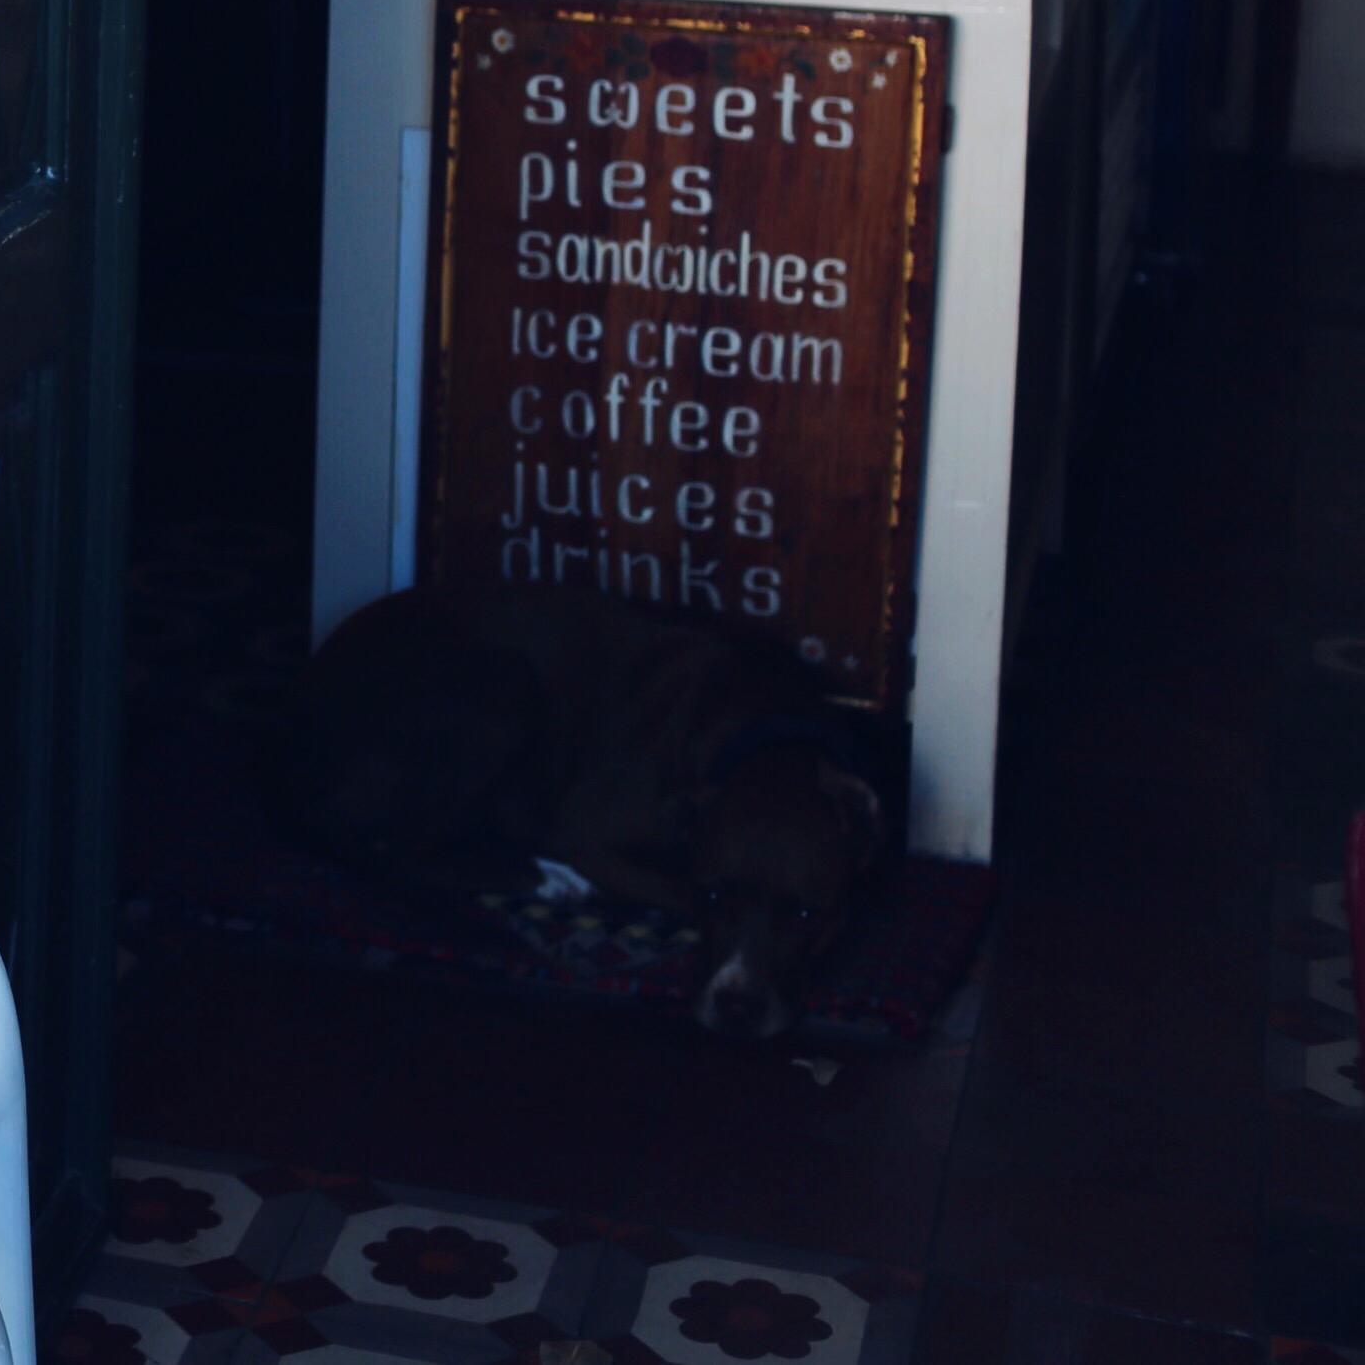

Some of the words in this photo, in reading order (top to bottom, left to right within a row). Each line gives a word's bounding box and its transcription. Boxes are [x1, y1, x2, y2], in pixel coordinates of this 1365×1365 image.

[524, 73, 854, 149] sweets
[519, 140, 713, 220] pies
[517, 221, 848, 308] sandwiches
[626, 316, 844, 385] cream
[509, 373, 762, 457] coffee
[501, 442, 776, 538] juices
[500, 526, 783, 617] drinks
